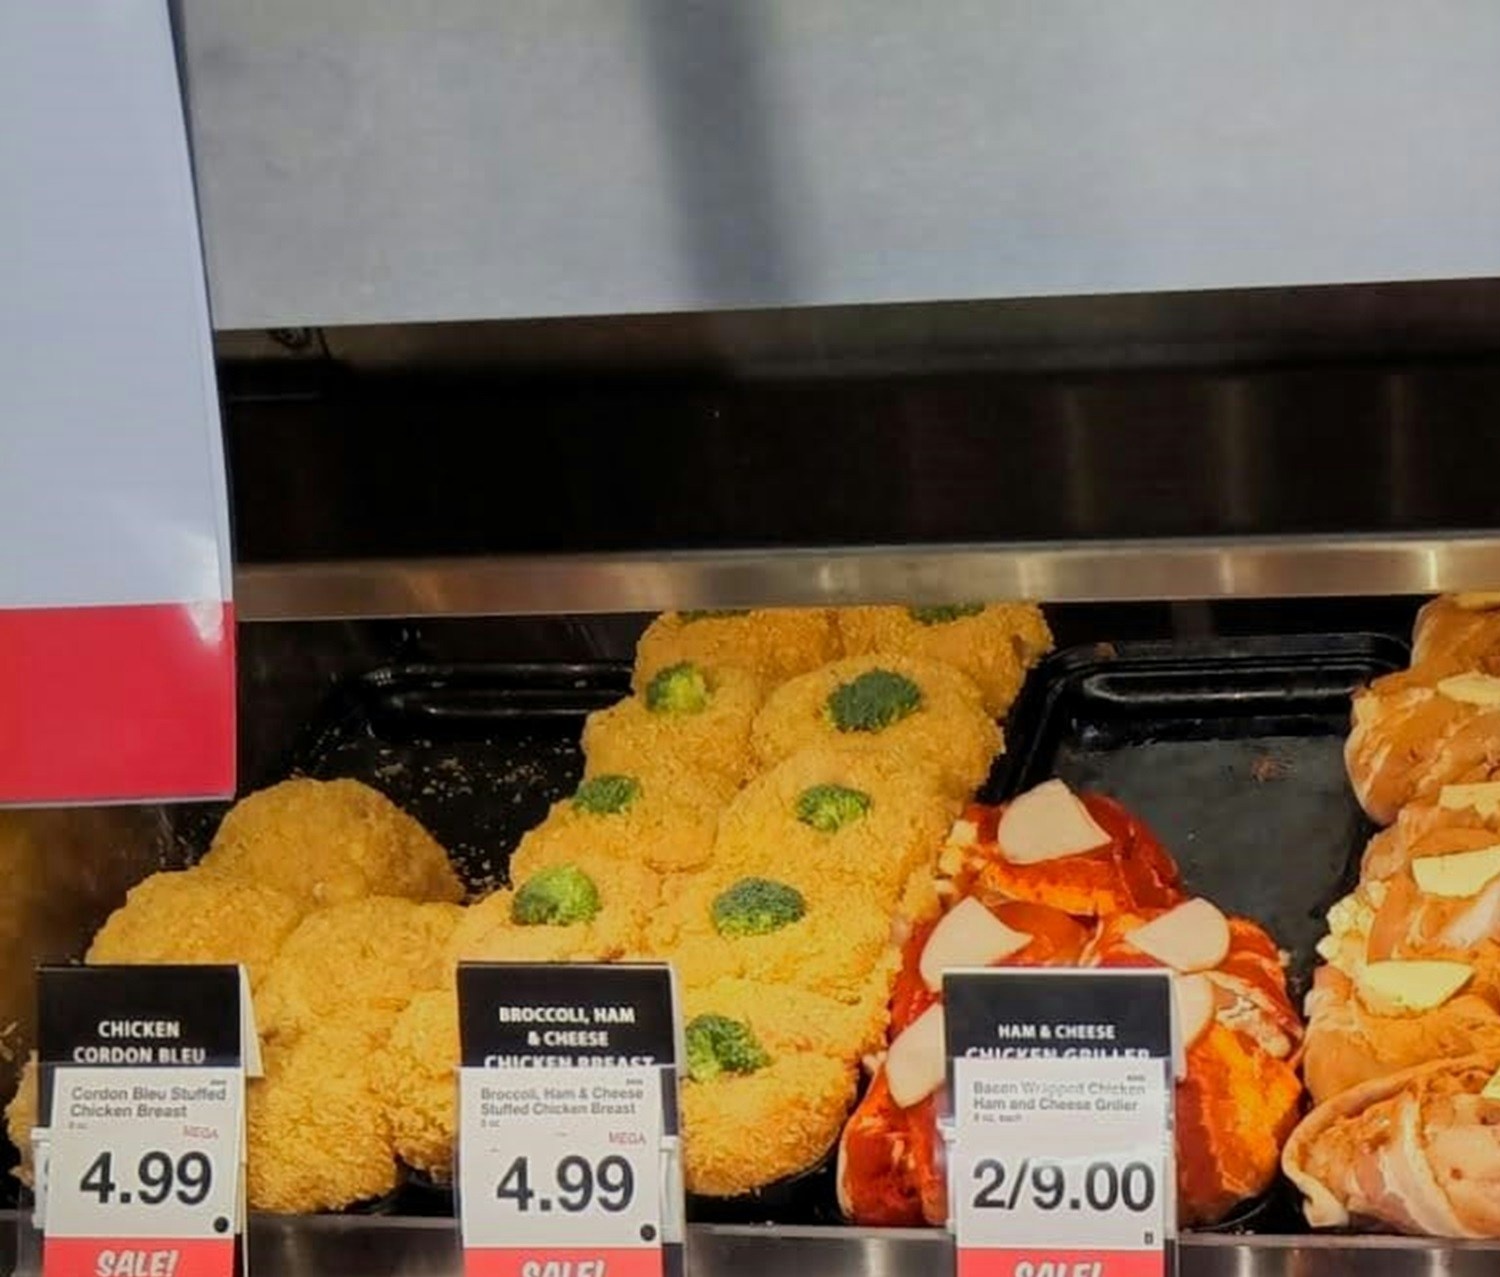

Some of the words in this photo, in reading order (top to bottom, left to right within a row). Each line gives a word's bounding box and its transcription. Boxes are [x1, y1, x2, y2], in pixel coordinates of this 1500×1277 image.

[500, 1007, 590, 1024] BROCCOLI,
[594, 1008, 635, 1023] HAM
[98, 1020, 180, 1038] CHICKEN
[999, 1025, 1036, 1039] HAM
[1040, 1025, 1051, 1038] &
[1055, 1025, 1116, 1040] CHEESE
[527, 1032, 540, 1046] &
[544, 1032, 609, 1047] CHEESE
[73, 1047, 151, 1063] CORDON
[159, 1048, 206, 1063] BLEU
[965, 1047, 1058, 1059] CHICKEN
[484, 1055, 573, 1068] CHICKEN
[71, 1087, 128, 1101] Cordon
[133, 1087, 166, 1101] Bleu
[171, 1087, 227, 1101] Stuffed
[544, 1089, 575, 1100] Ham
[592, 1088, 644, 1099] Cheese
[973, 1081, 1018, 1094] Bacon
[1088, 1083, 1145, 1095] Chicken
[70, 1104, 132, 1117] Chicken
[137, 1105, 187, 1117] Breast
[481, 1102, 529, 1115] Stuffed
[533, 1104, 587, 1115] Chicken
[591, 1104, 636, 1115] Breast
[973, 1098, 1006, 1110] Ham
[1010, 1099, 1035, 1111] and
[1039, 1099, 1090, 1111] Cheese
[1095, 1099, 1138, 1112] Griller
[609, 1132, 647, 1145] MEGA
[79, 1151, 213, 1205] 4.99
[496, 1155, 634, 1212] 4.99
[973, 1157, 1155, 1212] 2/9.00
